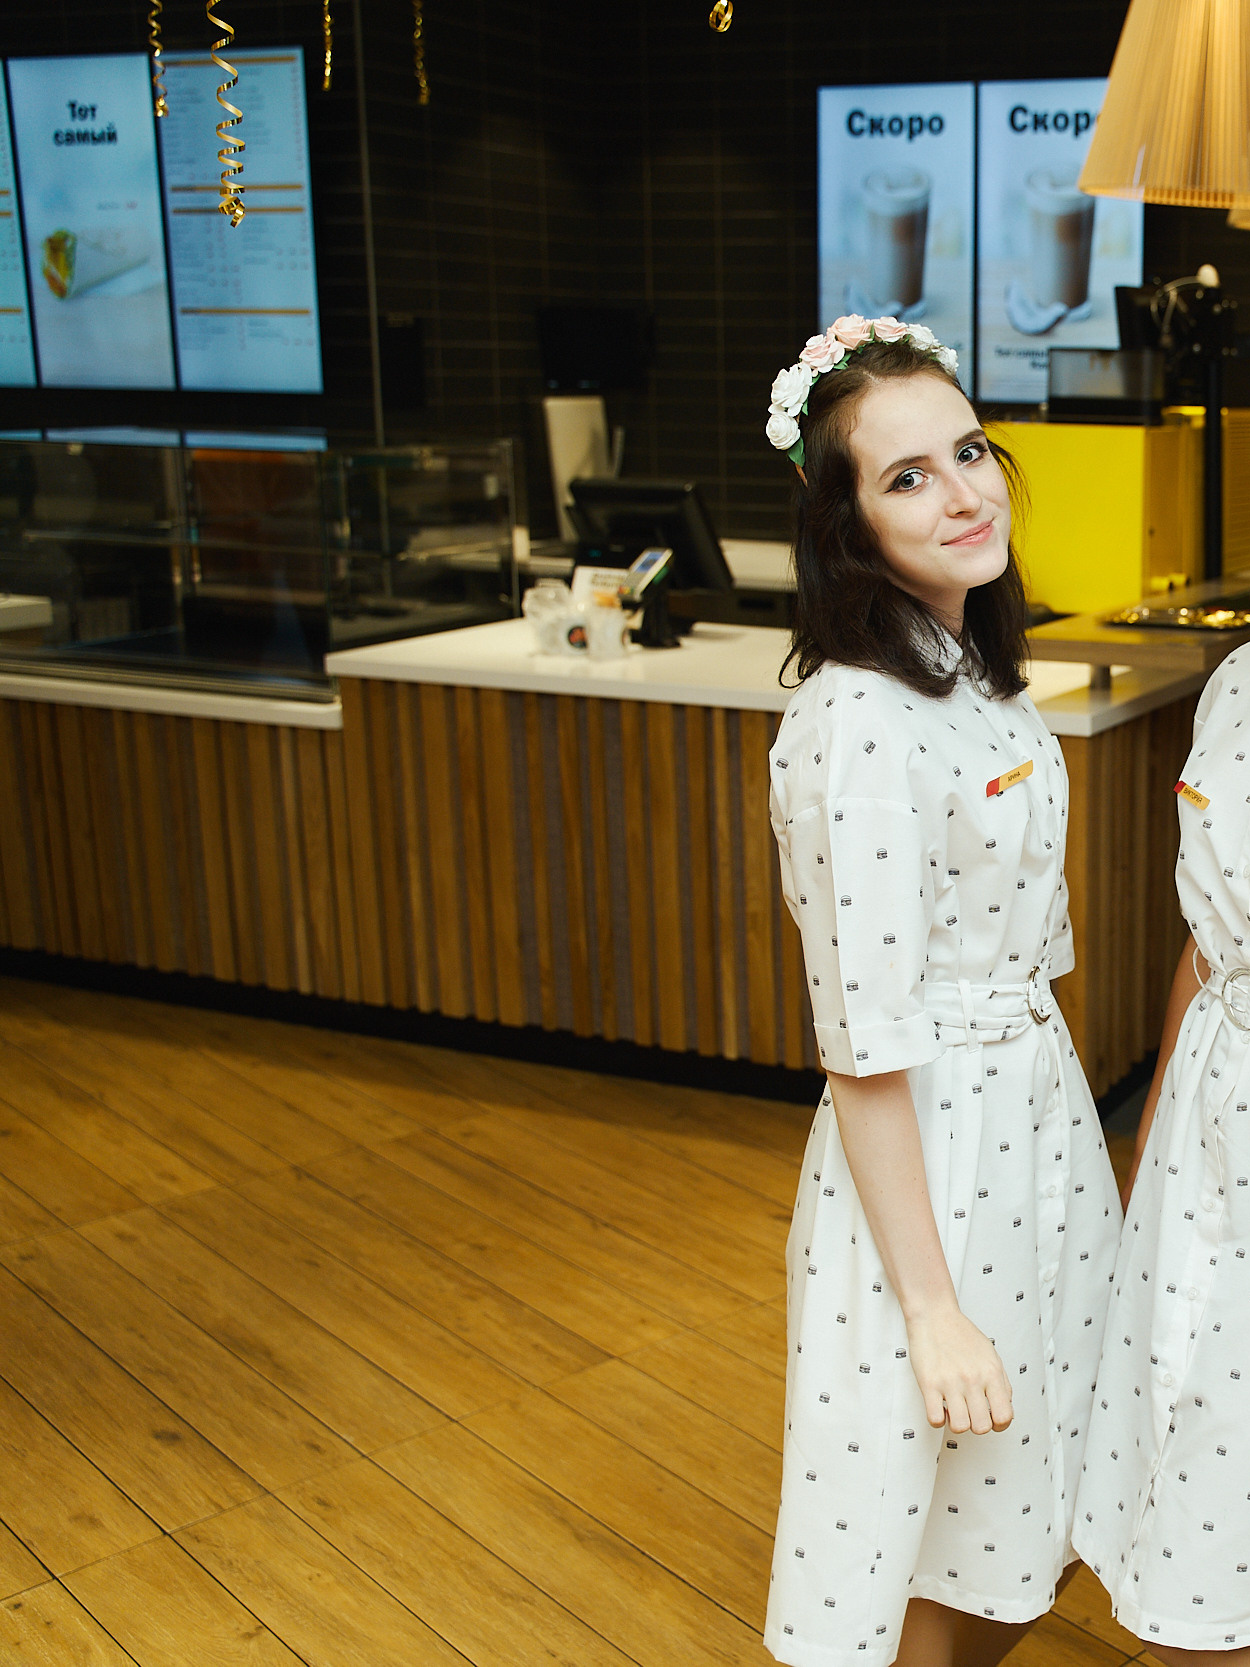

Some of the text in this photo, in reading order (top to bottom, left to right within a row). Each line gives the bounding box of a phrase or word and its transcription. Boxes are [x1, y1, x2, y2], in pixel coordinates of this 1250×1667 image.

[67, 100, 98, 120] Тот
[1009, 105, 1096, 138] Скор
[53, 122, 117, 145] самый
[847, 109, 945, 141] Скоро
